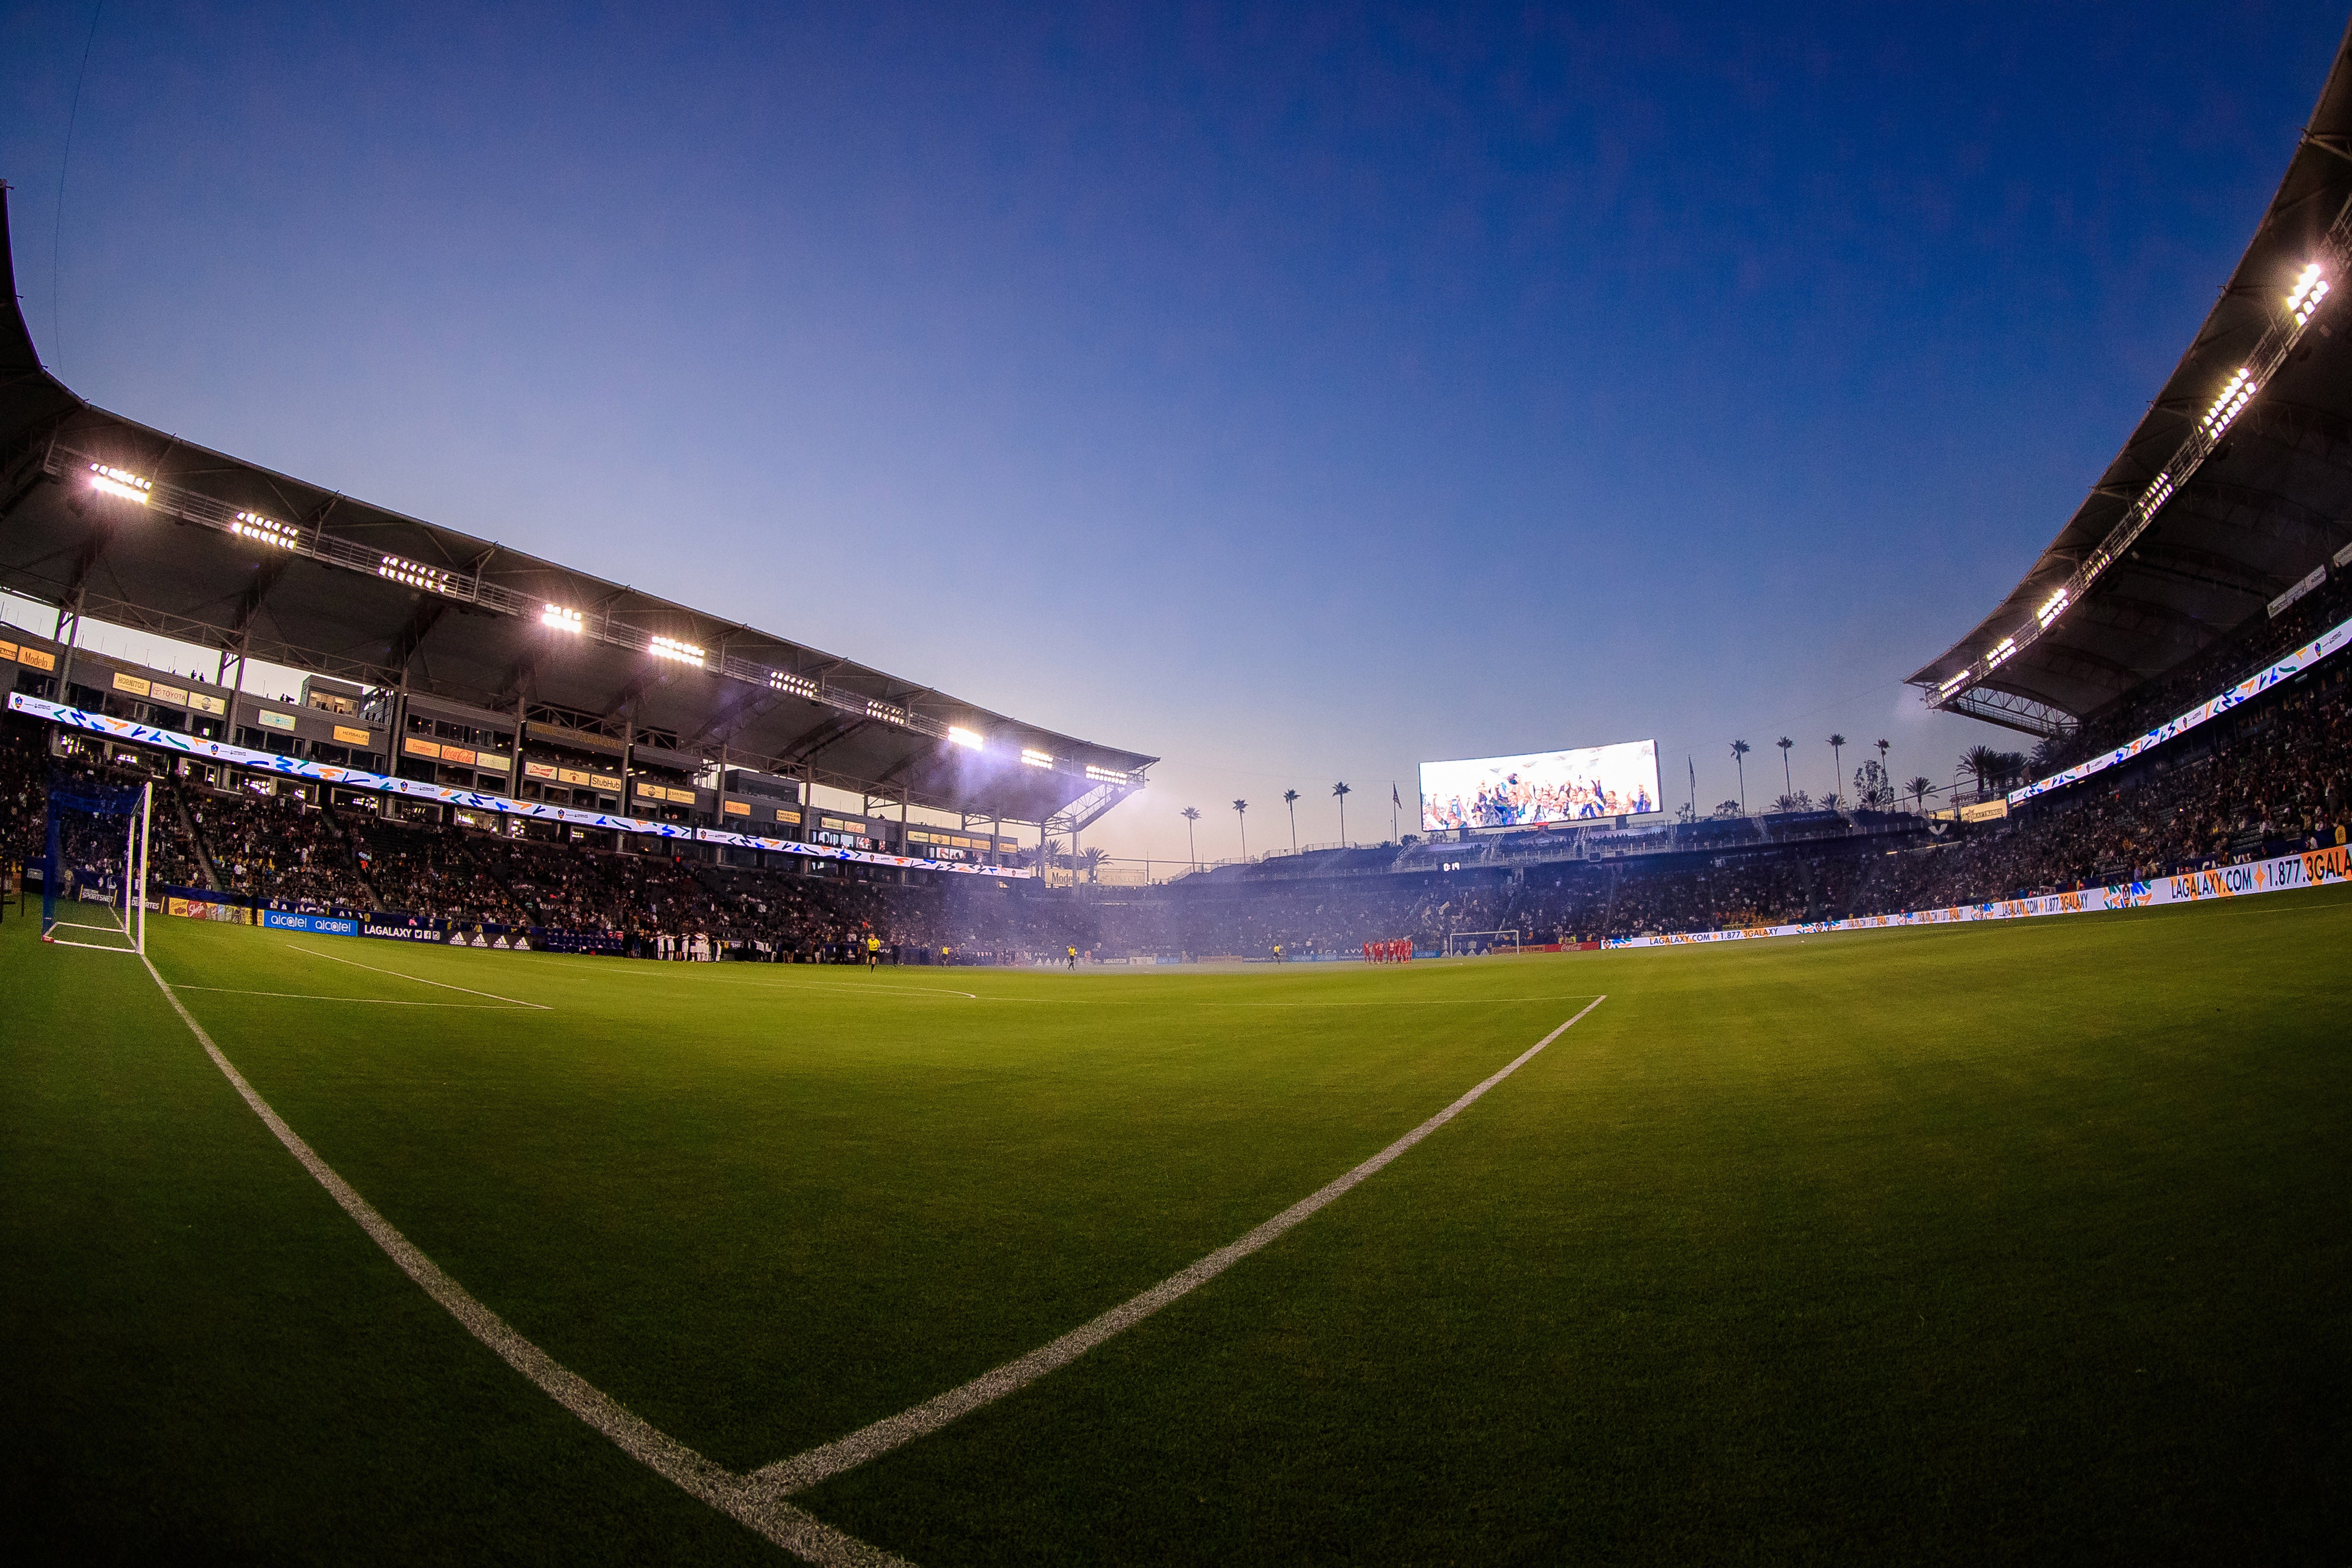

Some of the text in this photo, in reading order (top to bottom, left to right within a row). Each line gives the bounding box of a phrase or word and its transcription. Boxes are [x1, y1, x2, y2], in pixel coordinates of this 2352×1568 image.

[24, 651, 48, 668] Modelo
[118, 676, 145, 688] HORNITOS
[162, 689, 186, 700] TOYOTA
[263, 713, 292, 726] alcatel
[343, 731, 368, 739] HERBALIFE
[413, 743, 431, 752] Frontier
[443, 747, 473, 763] Coca-Cola
[531, 766, 551, 775] Budweiser
[592, 777, 620, 789] StubHub
[1444, 862, 1460, 871] 0:19
[2171, 867, 2252, 899] LAGALAXY.COM
[82, 892, 114, 903] SPORTSNET
[131, 899, 159, 909] DERTES
[2002, 893, 2088, 917] LAGALAXY.COM 1.877.3GALAXY
[271, 914, 307, 928] alcatel
[315, 919, 350, 932] alcatel
[364, 924, 412, 938] LAGALAXY
[1650, 927, 1778, 945] LAGALAXY.COM 1.877.3GALAXY
